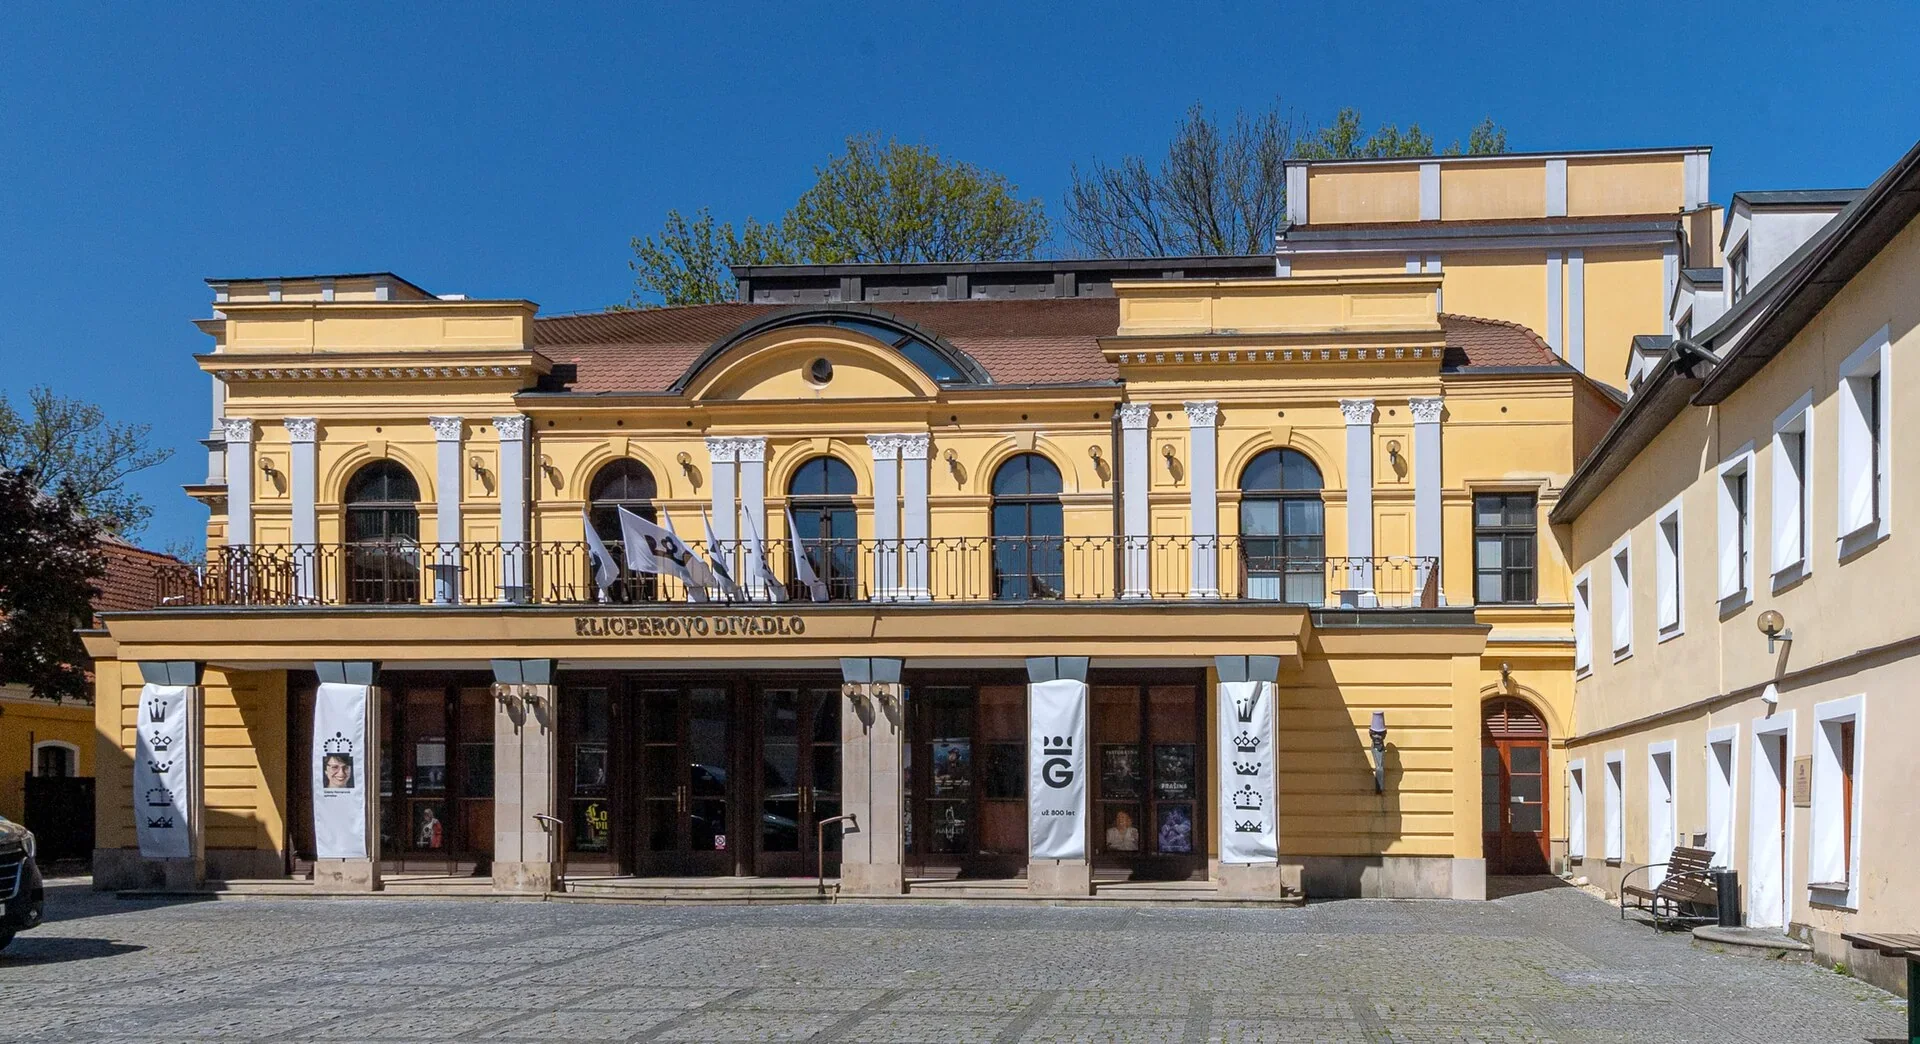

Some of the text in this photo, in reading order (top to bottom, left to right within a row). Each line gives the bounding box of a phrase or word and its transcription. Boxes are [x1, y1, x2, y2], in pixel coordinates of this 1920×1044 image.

[574, 615, 806, 638] KLICPEROVO DIVADLO
[1042, 757, 1074, 789] G
